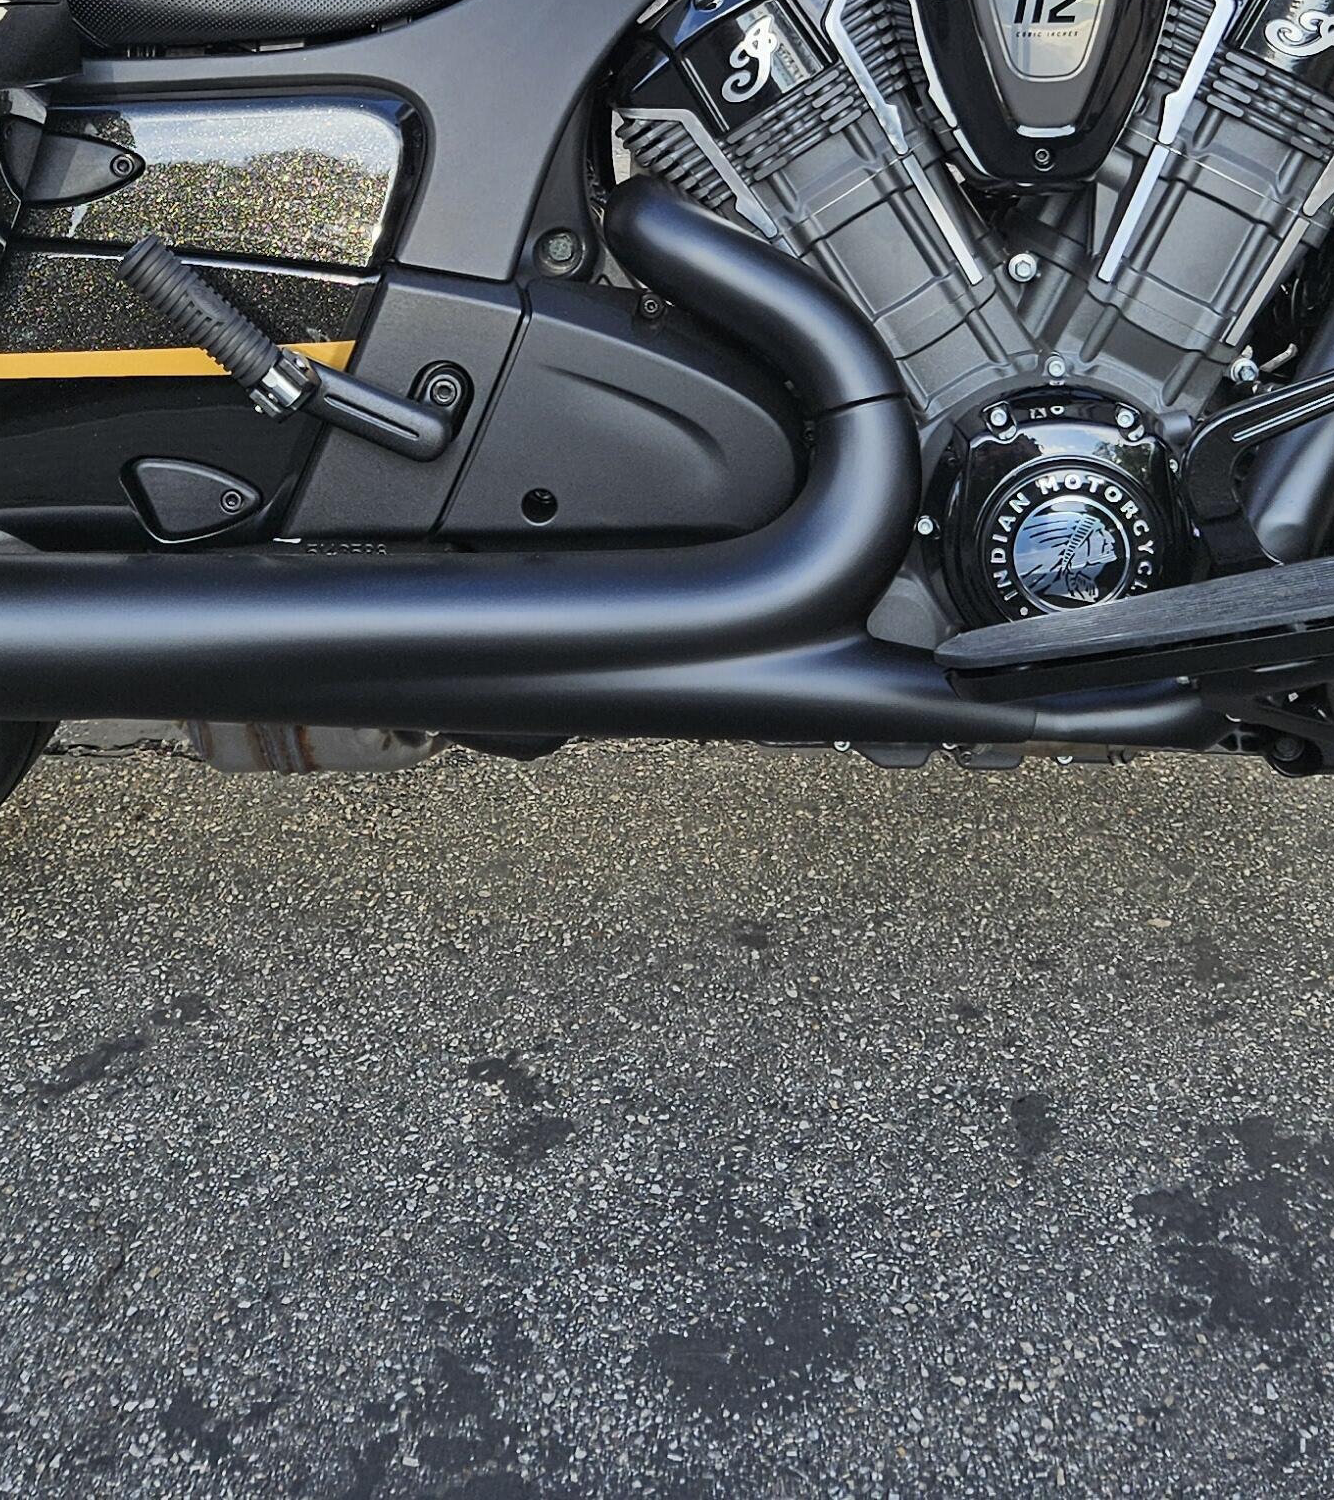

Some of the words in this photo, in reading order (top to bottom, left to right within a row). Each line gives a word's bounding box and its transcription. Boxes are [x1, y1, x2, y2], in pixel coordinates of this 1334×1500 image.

[1015, 30, 1043, 38] CUBIC
[1047, 30, 1078, 38] INCHES
[990, 492, 1031, 601] INDIAN
[1034, 473, 1155, 592] MOTORCYCL
